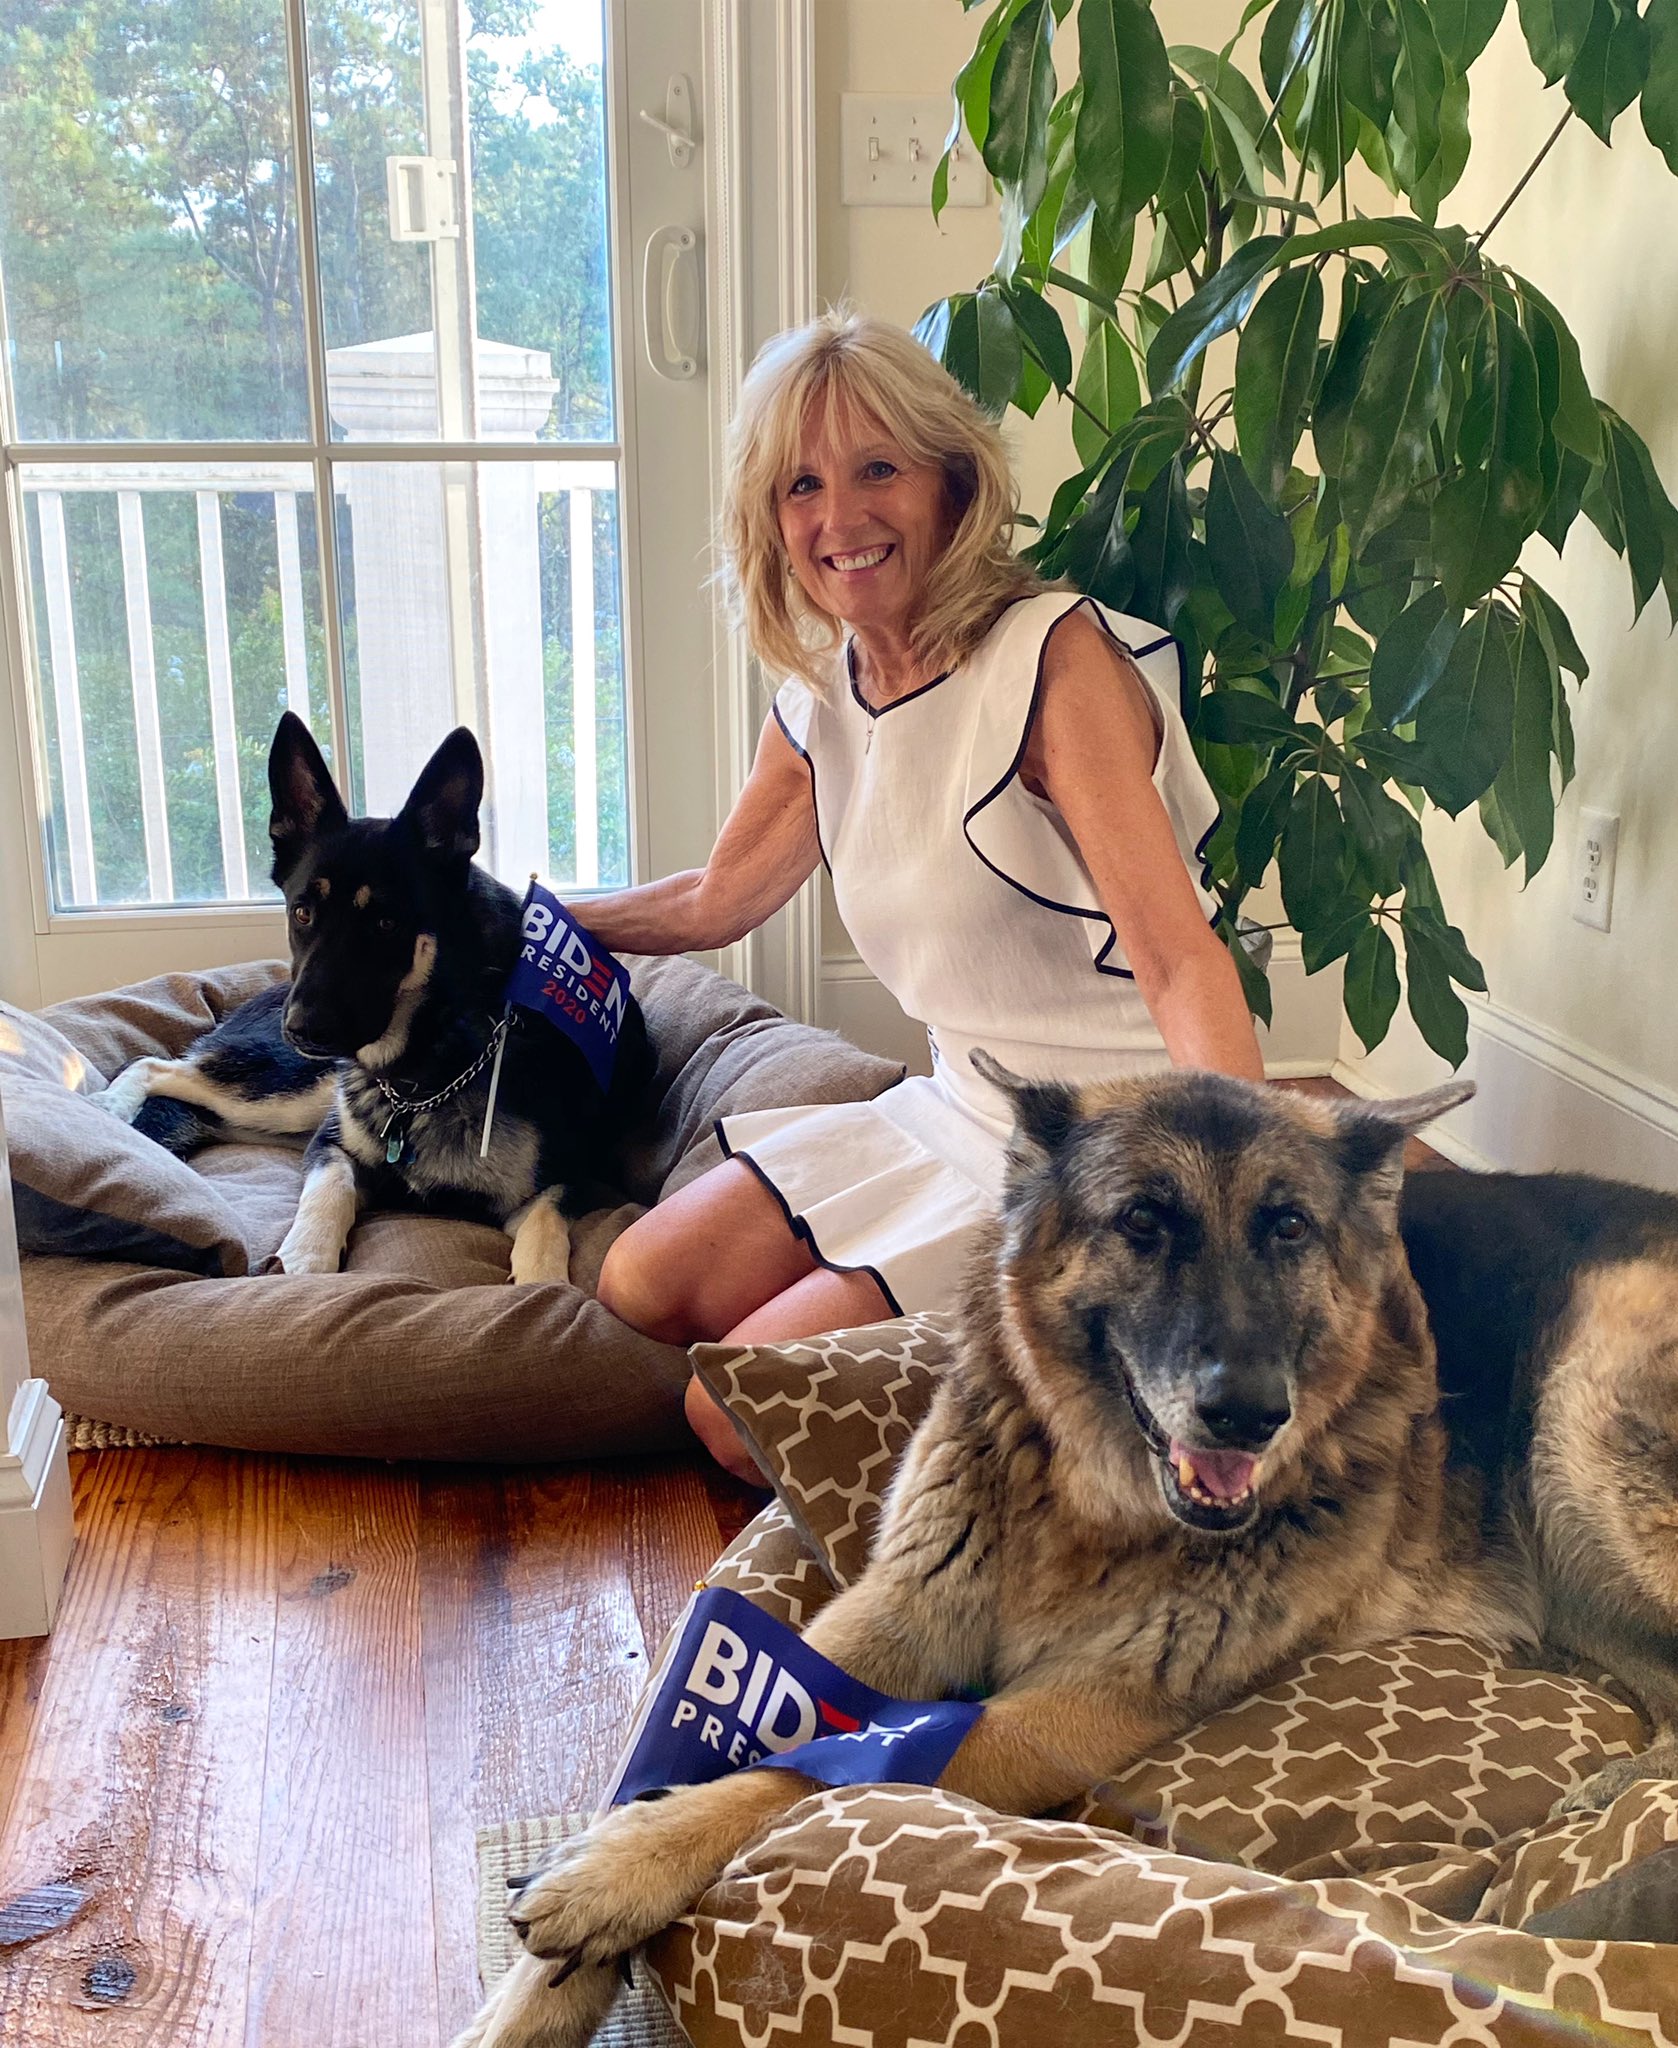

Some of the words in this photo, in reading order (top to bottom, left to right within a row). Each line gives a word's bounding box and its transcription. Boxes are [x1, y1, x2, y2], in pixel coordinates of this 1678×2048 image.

[520, 943, 617, 1044] RESIDENT
[521, 902, 627, 1034] BIDEN
[542, 979, 587, 1024] 2020
